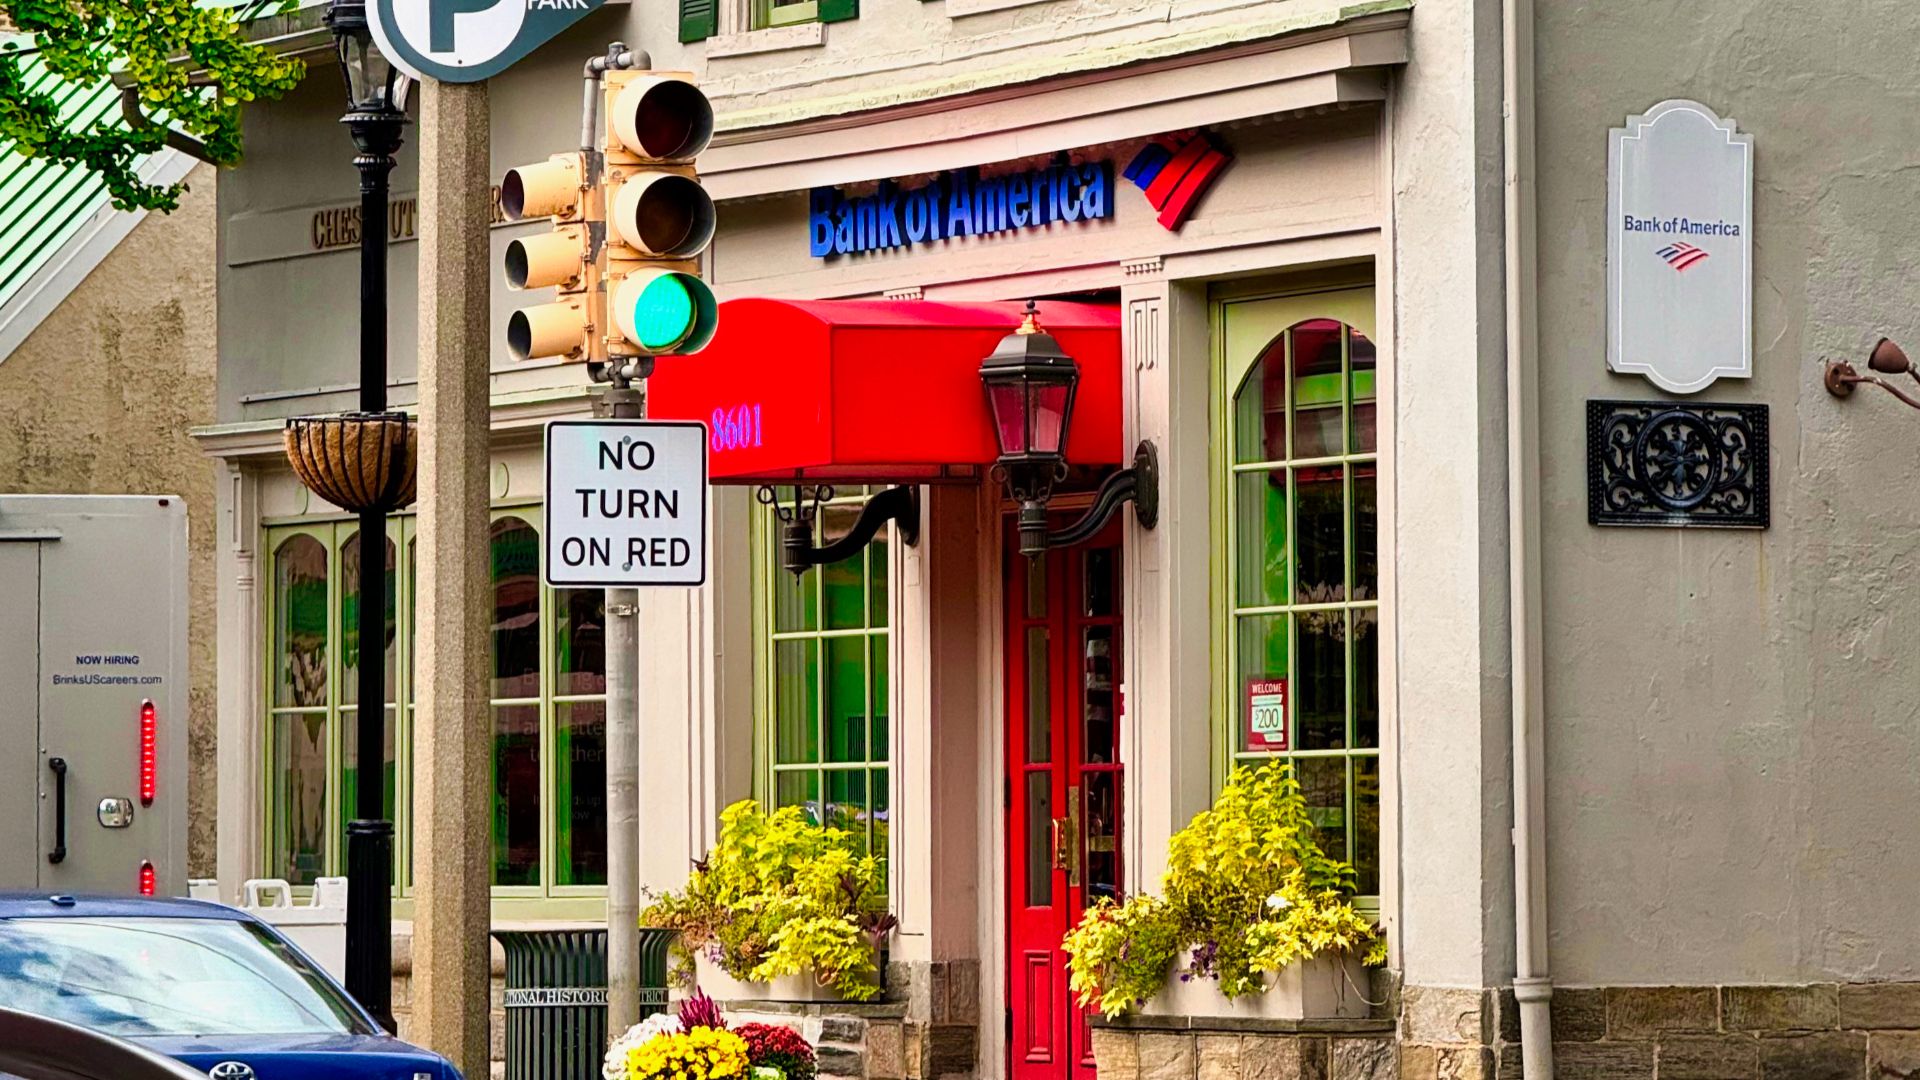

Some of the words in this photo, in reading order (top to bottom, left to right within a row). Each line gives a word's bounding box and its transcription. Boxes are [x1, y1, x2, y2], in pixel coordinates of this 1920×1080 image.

[809, 184, 900, 258] Bank
[904, 186, 941, 243] of
[946, 158, 1107, 238] America
[311, 198, 416, 250] CHESUT
[1624, 215, 1660, 232] Bank
[1663, 217, 1678, 234] of
[1680, 218, 1740, 236] America
[711, 403, 762, 453] 8601
[598, 440, 655, 471] NO
[575, 488, 679, 519] TURN
[562, 536, 611, 567] ON
[627, 537, 691, 567] RED
[76, 655, 101, 665] NOW
[104, 655, 140, 665] HIRING
[52, 674, 163, 685] BrinksUScareers.com
[1251, 683, 1283, 694] WELCOME
[1254, 708, 1280, 729] $200
[547, 990, 608, 1004] HISTORI
